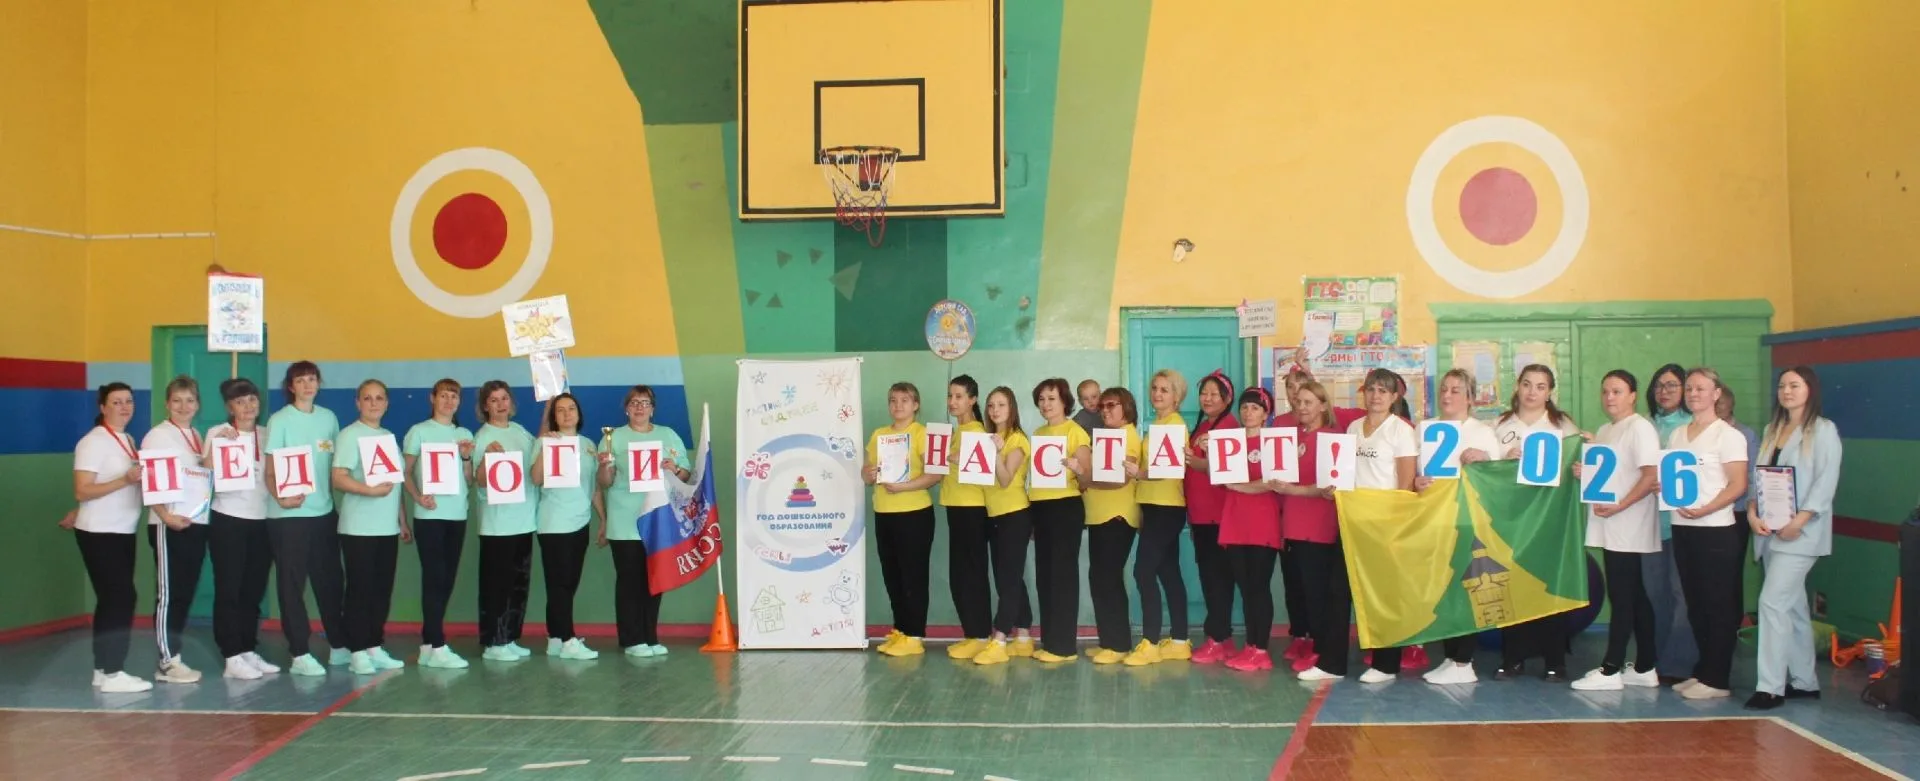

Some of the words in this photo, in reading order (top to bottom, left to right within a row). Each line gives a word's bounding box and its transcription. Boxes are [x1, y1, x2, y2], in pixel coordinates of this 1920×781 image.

[1361, 351, 1384, 361] ГТО
[757, 513, 775, 521] ГОД
[777, 511, 846, 521] ДОШКОЛЬНОГО
[769, 522, 833, 531] ОБРАЗОВАНИЯ
